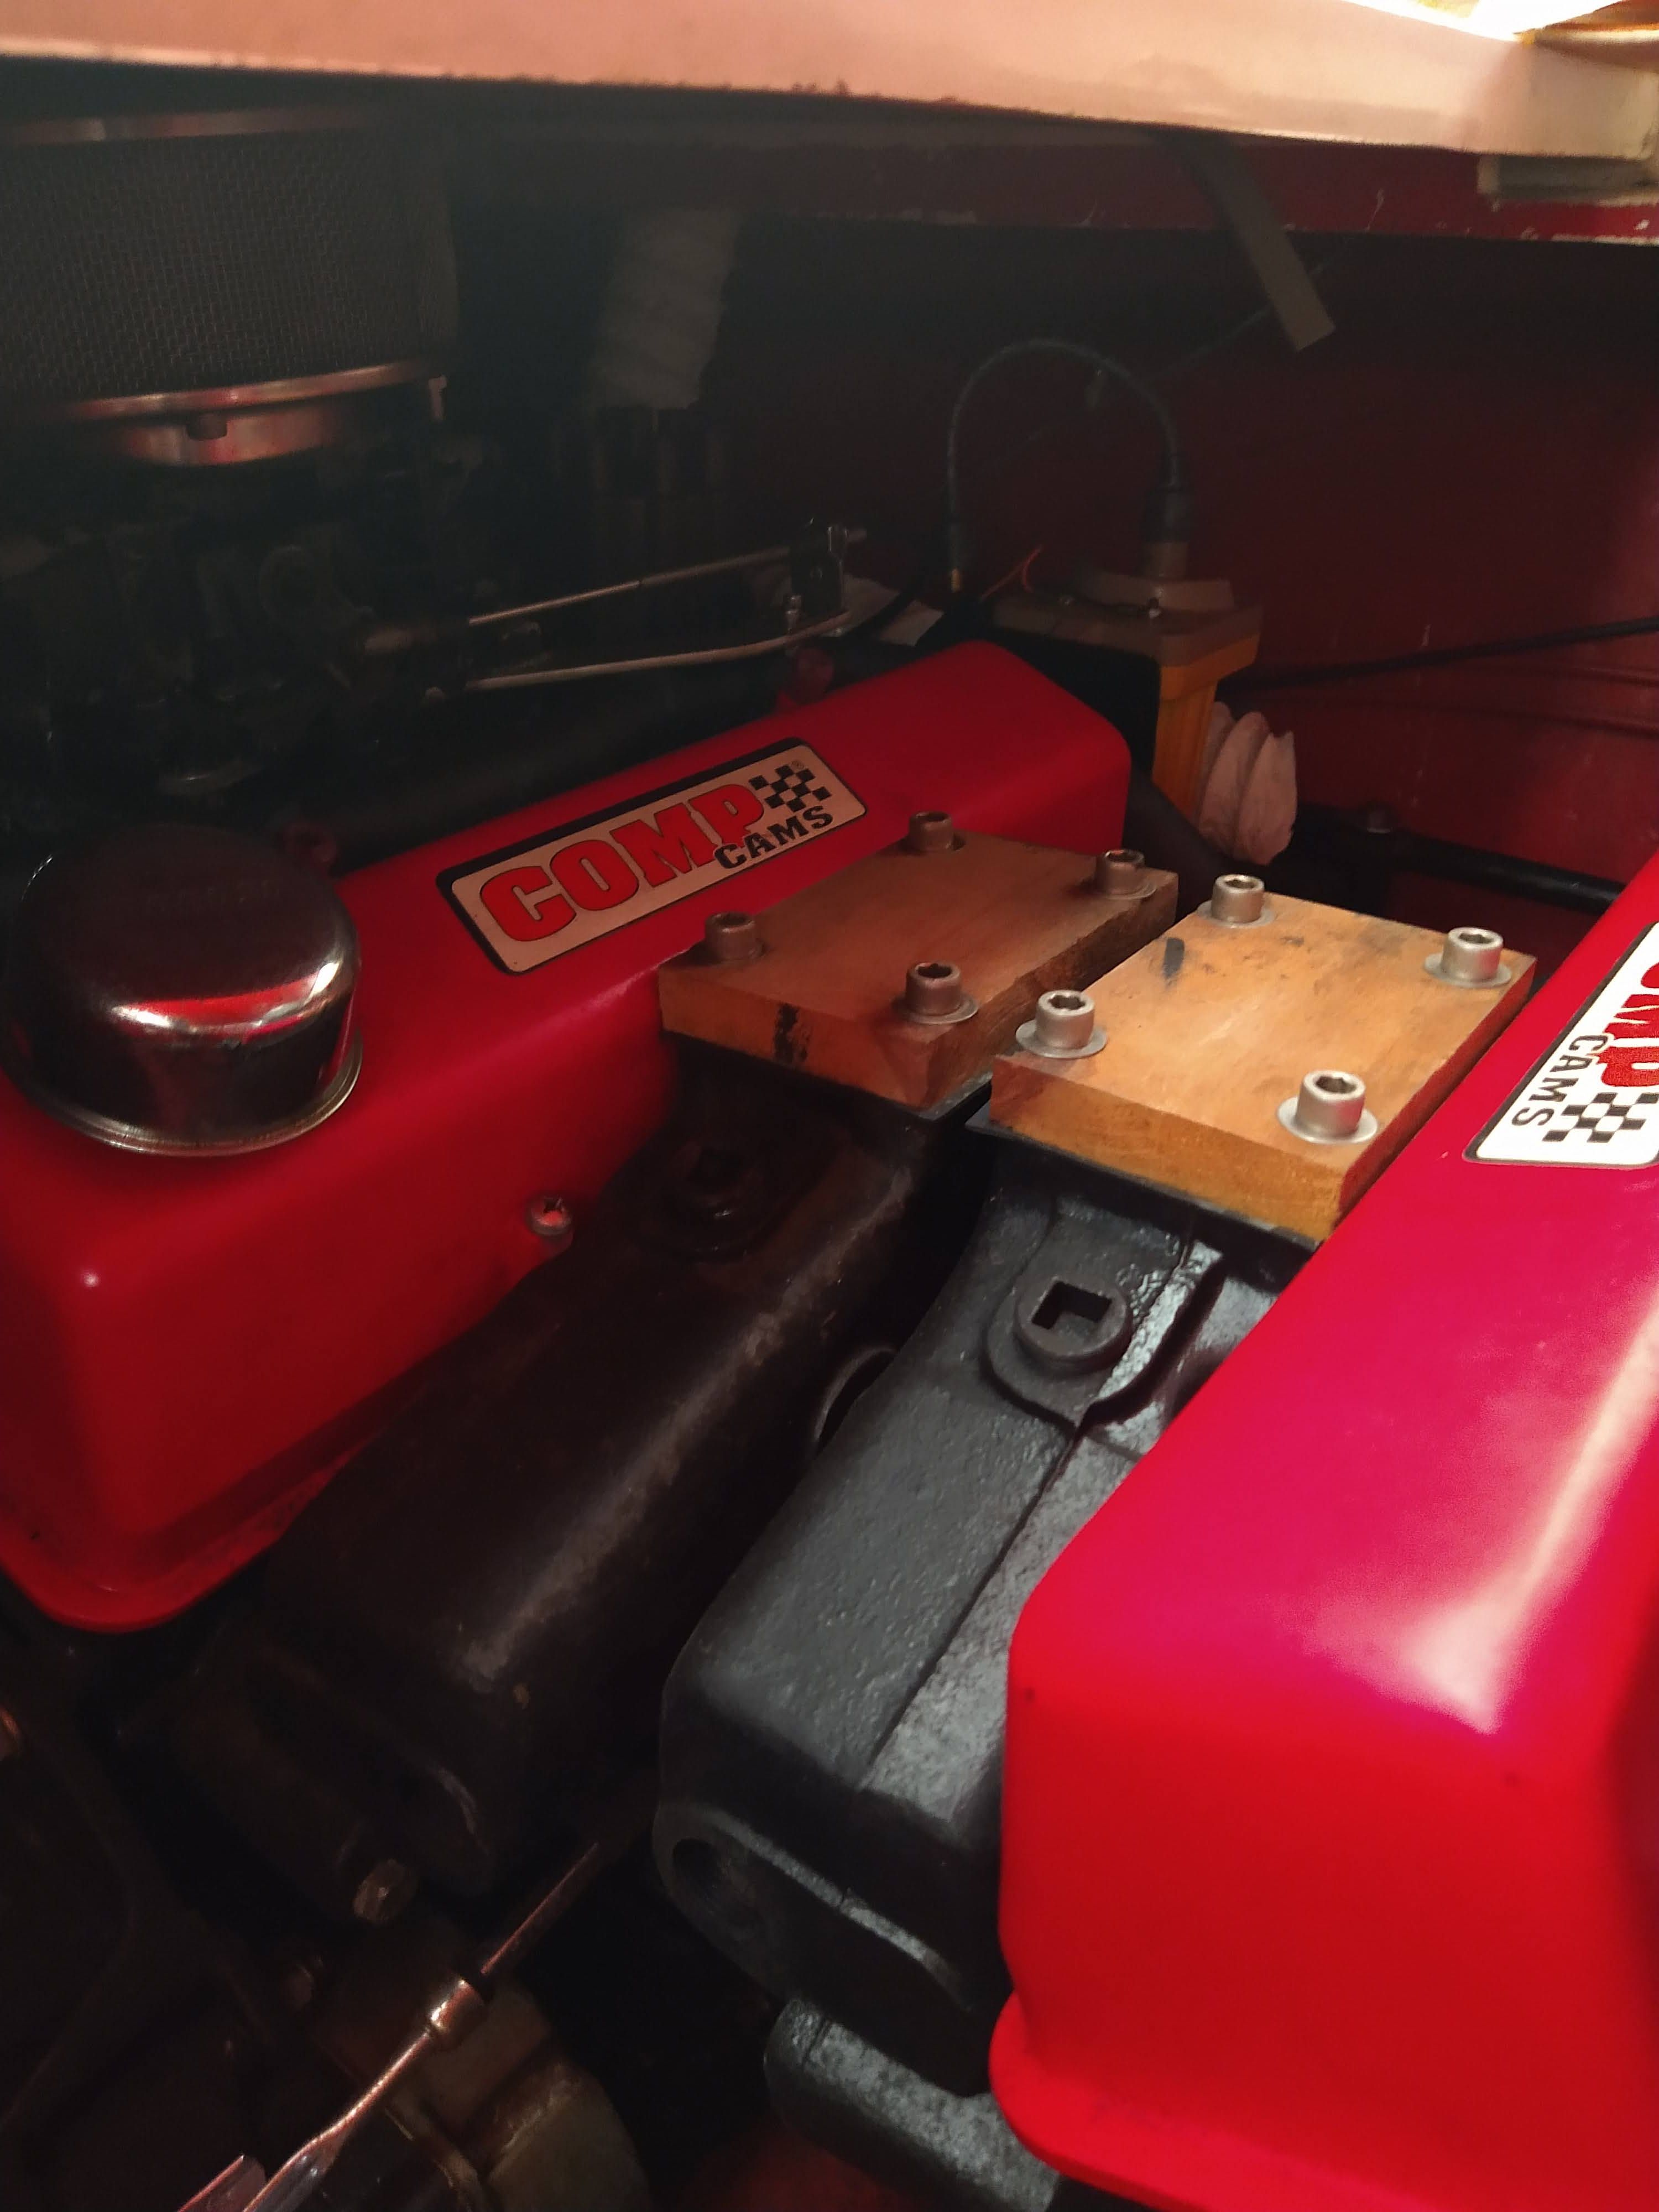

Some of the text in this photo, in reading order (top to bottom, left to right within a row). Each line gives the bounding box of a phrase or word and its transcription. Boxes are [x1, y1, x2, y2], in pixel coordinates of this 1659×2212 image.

[480, 784, 764, 942] COMP
[714, 806, 833, 869] CAMS
[1511, 1035, 1608, 1126] CAMS
